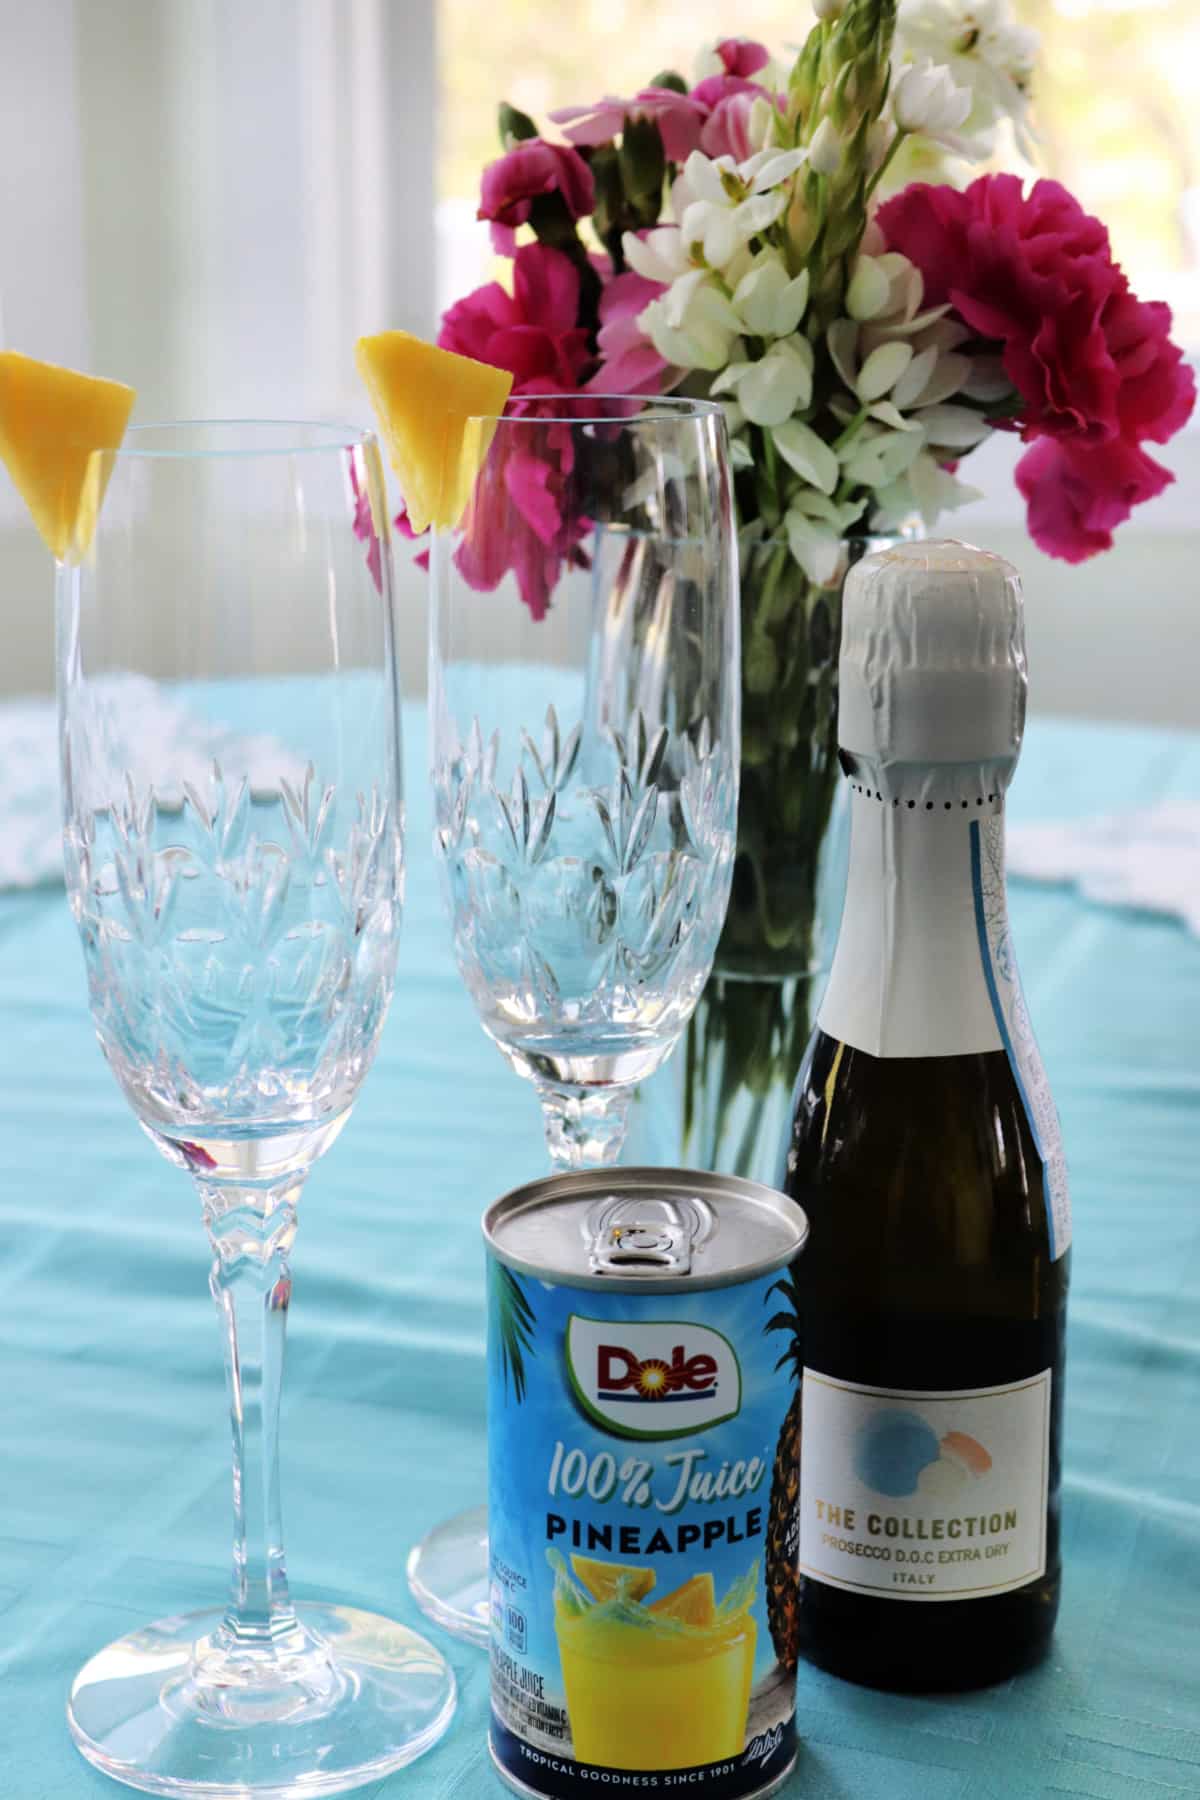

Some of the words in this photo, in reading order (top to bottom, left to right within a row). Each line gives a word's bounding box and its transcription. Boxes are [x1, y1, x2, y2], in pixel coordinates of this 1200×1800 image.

[548, 1441, 652, 1504] 100%
[655, 1449, 766, 1513] Juice
[546, 1507, 763, 1554] PINEAPPLE
[815, 1499, 856, 1531] THE
[867, 1509, 1017, 1540] COLLECTION
[822, 1534, 891, 1562] PROSECCO
[938, 1547, 981, 1564] EXTRA
[985, 1543, 1009, 1559] DRY
[893, 1572, 936, 1585] ITALY
[520, 1666, 545, 1700] JUICE
[520, 1745, 575, 1776] TROPICAL
[580, 1768, 658, 1786] GOODNESS
[664, 1771, 705, 1786] SINCE
[710, 1764, 735, 1779] 1901
